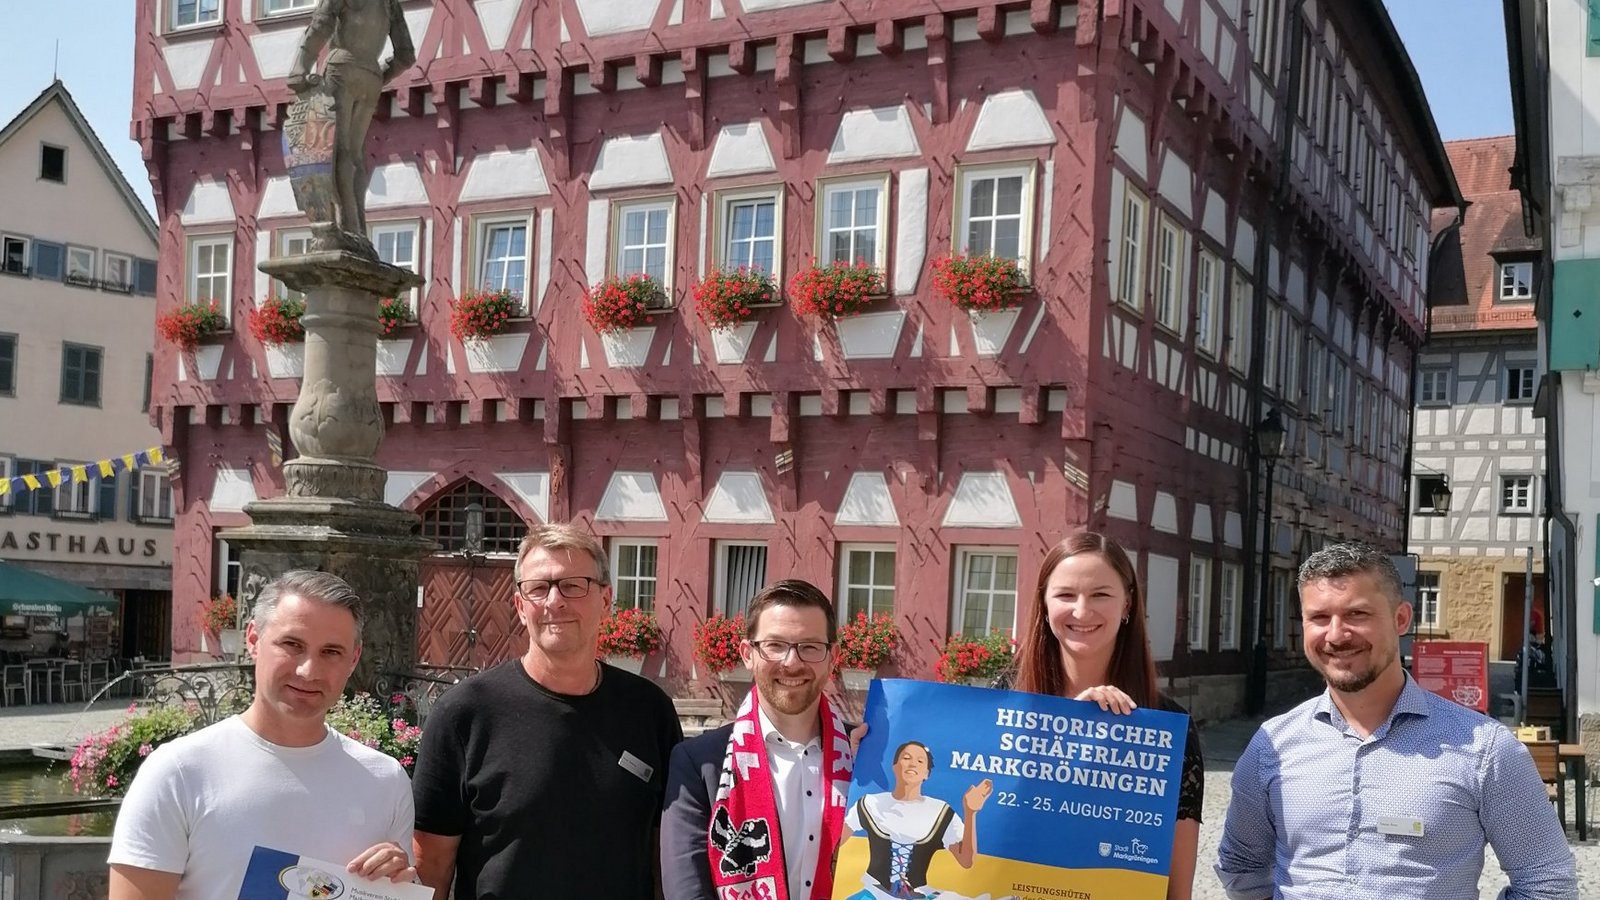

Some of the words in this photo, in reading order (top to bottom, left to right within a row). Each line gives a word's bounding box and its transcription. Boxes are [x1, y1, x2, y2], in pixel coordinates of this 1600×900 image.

[1, 531, 157, 557] ASTHAUS
[996, 708, 1173, 749] HISTORISCHER
[1000, 732, 1171, 772] SCHÄFERLAUF
[950, 751, 1168, 797] MARKGRÖNINGEN
[997, 791, 1020, 808] 22.
[1032, 796, 1055, 812] 25.
[1059, 801, 1122, 821] AUGUST
[1125, 809, 1163, 827] 2025
[1012, 883, 1091, 900] LEISTUNGSHÜTEN
